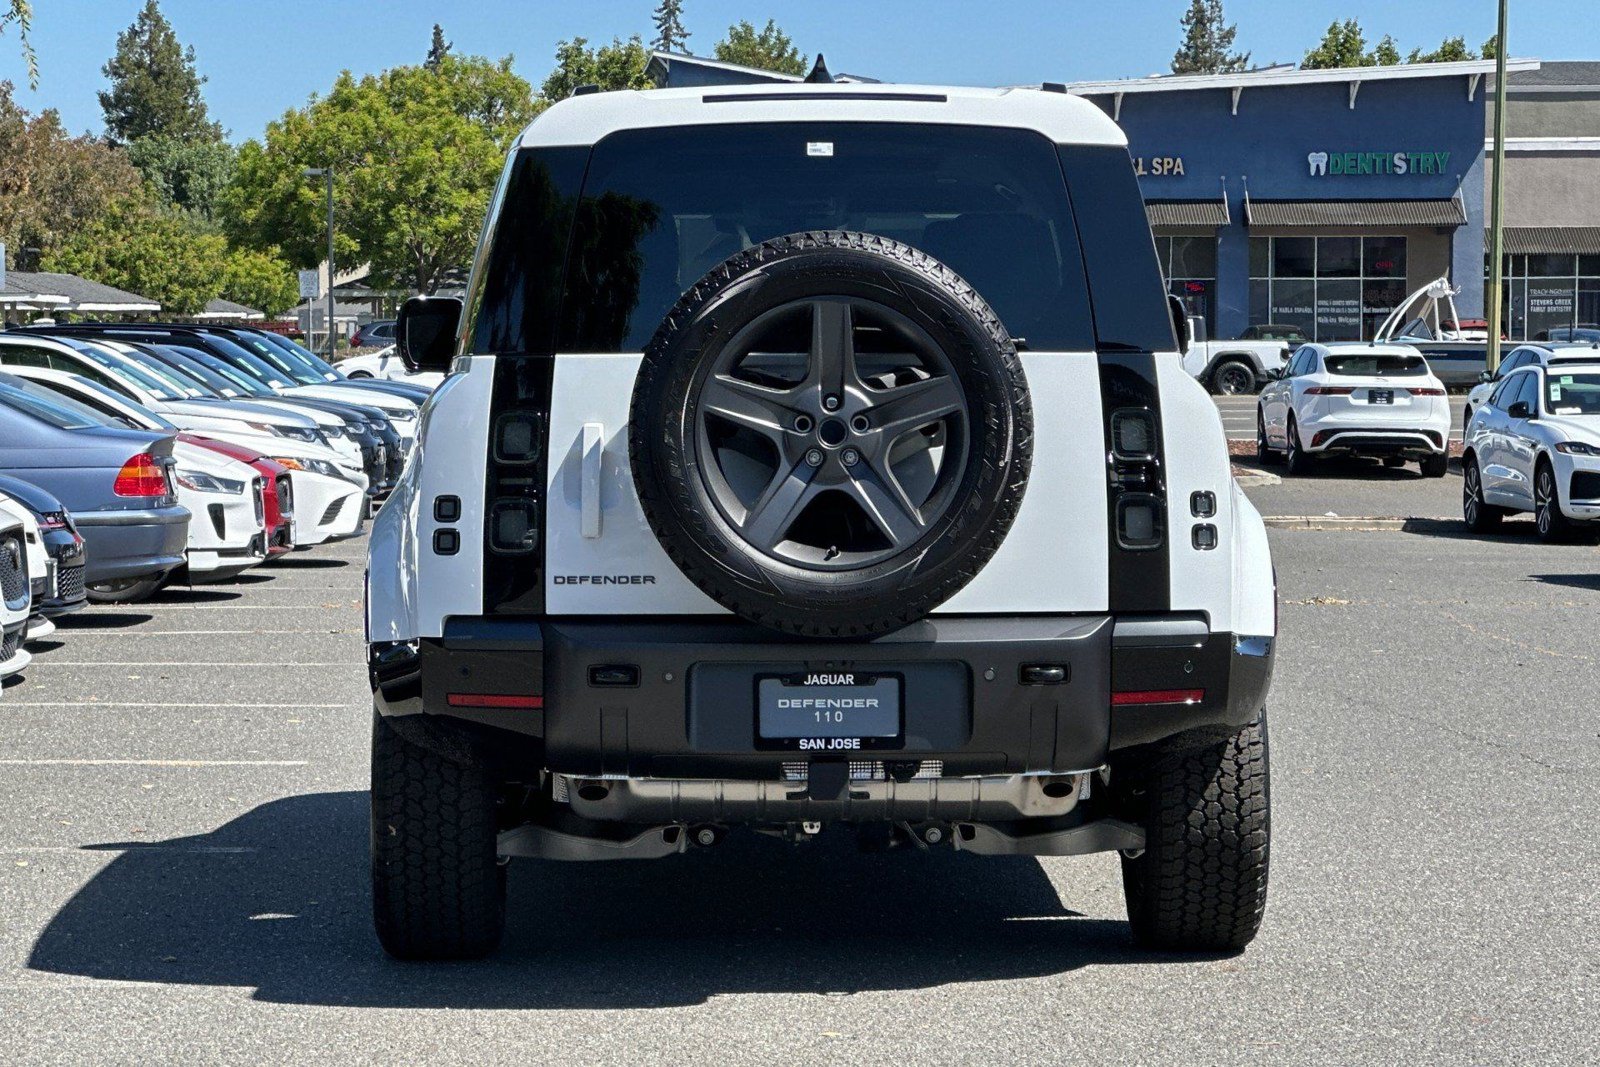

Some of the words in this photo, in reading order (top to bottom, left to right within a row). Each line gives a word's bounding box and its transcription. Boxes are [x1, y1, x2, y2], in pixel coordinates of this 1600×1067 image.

[1151, 157, 1185, 176] SPA
[1329, 152, 1451, 175] DENTISTRY
[553, 575, 656, 585] DEFENDER
[803, 674, 855, 685] JAGUAR
[777, 698, 879, 709] DEFENDER
[814, 711, 844, 722] 110
[799, 738, 827, 750] SAN
[827, 738, 861, 750] JOSE
